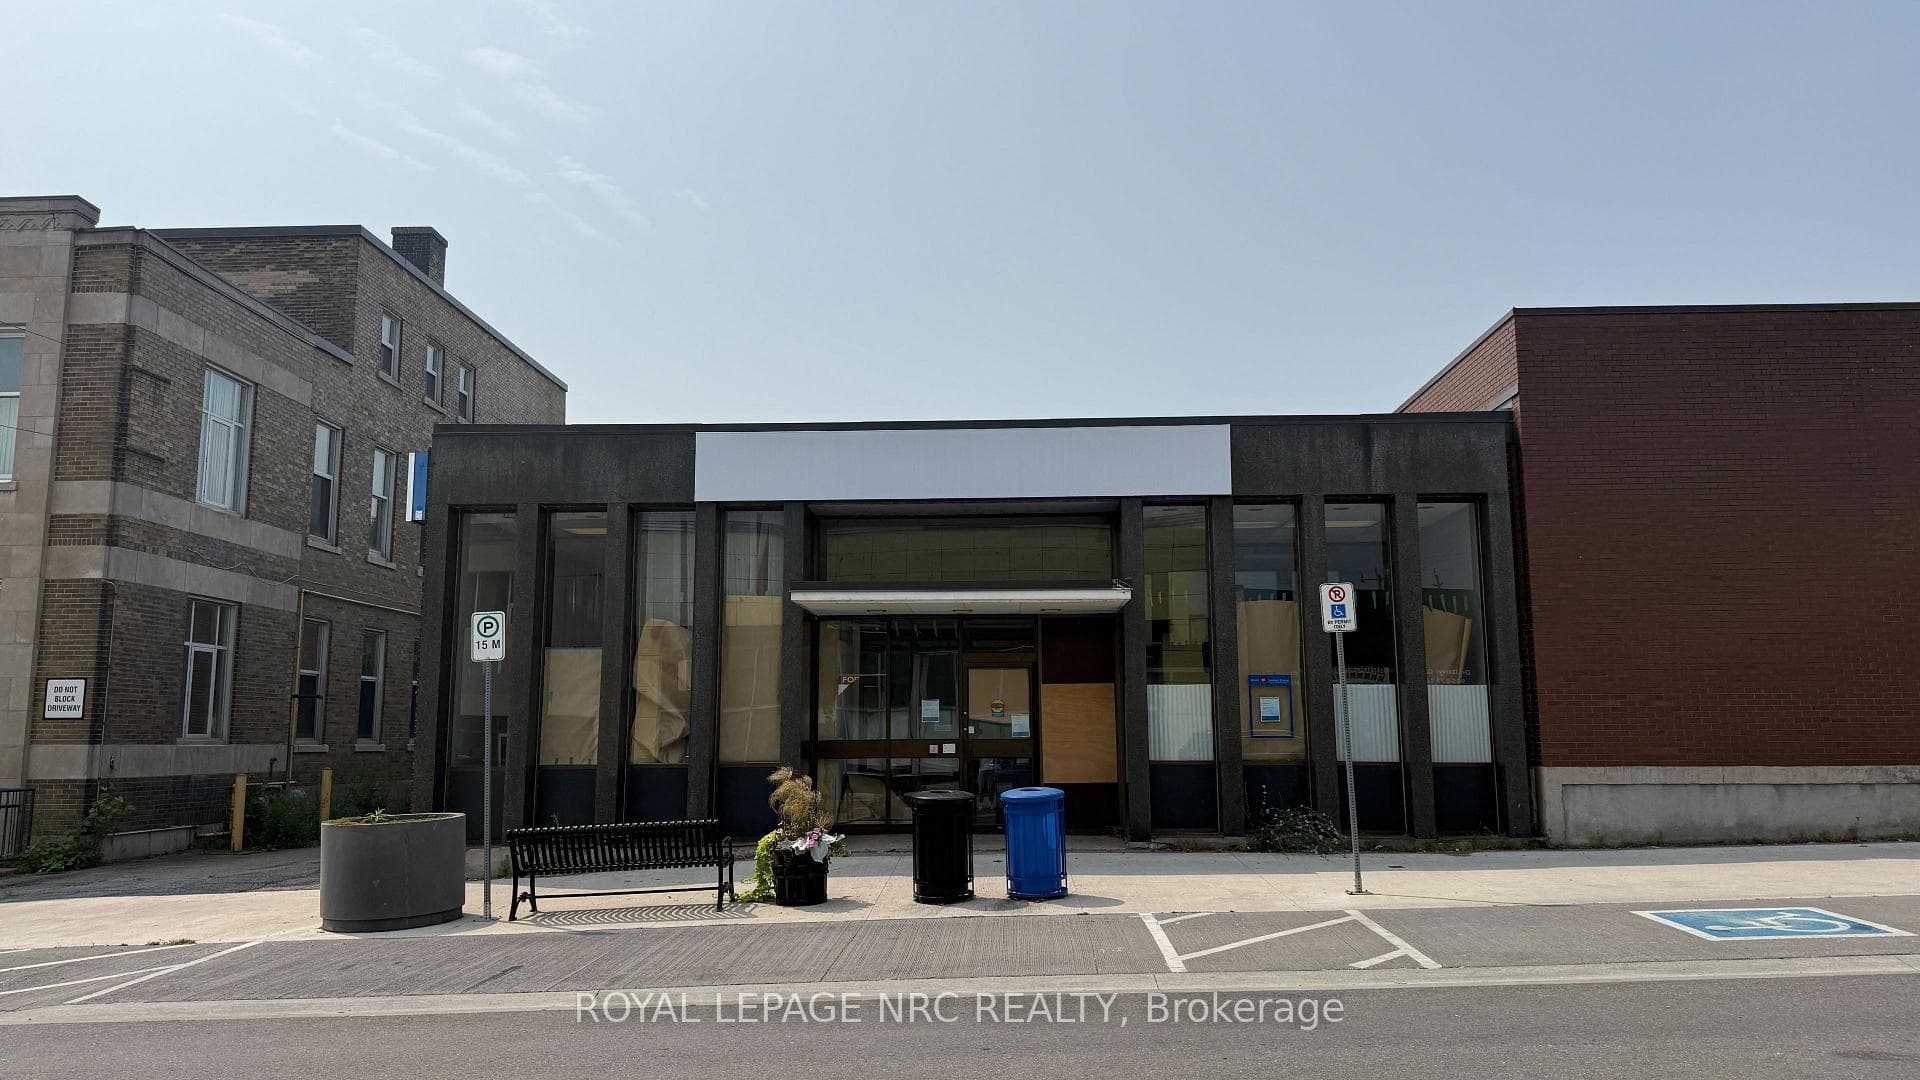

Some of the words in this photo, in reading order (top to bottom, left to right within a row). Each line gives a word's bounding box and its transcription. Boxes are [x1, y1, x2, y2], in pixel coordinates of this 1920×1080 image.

[483, 621, 494, 634] P
[476, 640, 488, 650] 15
[492, 639, 501, 649] M
[54, 695, 76, 703] BLOCK
[47, 704, 81, 712] DRIVEWAY
